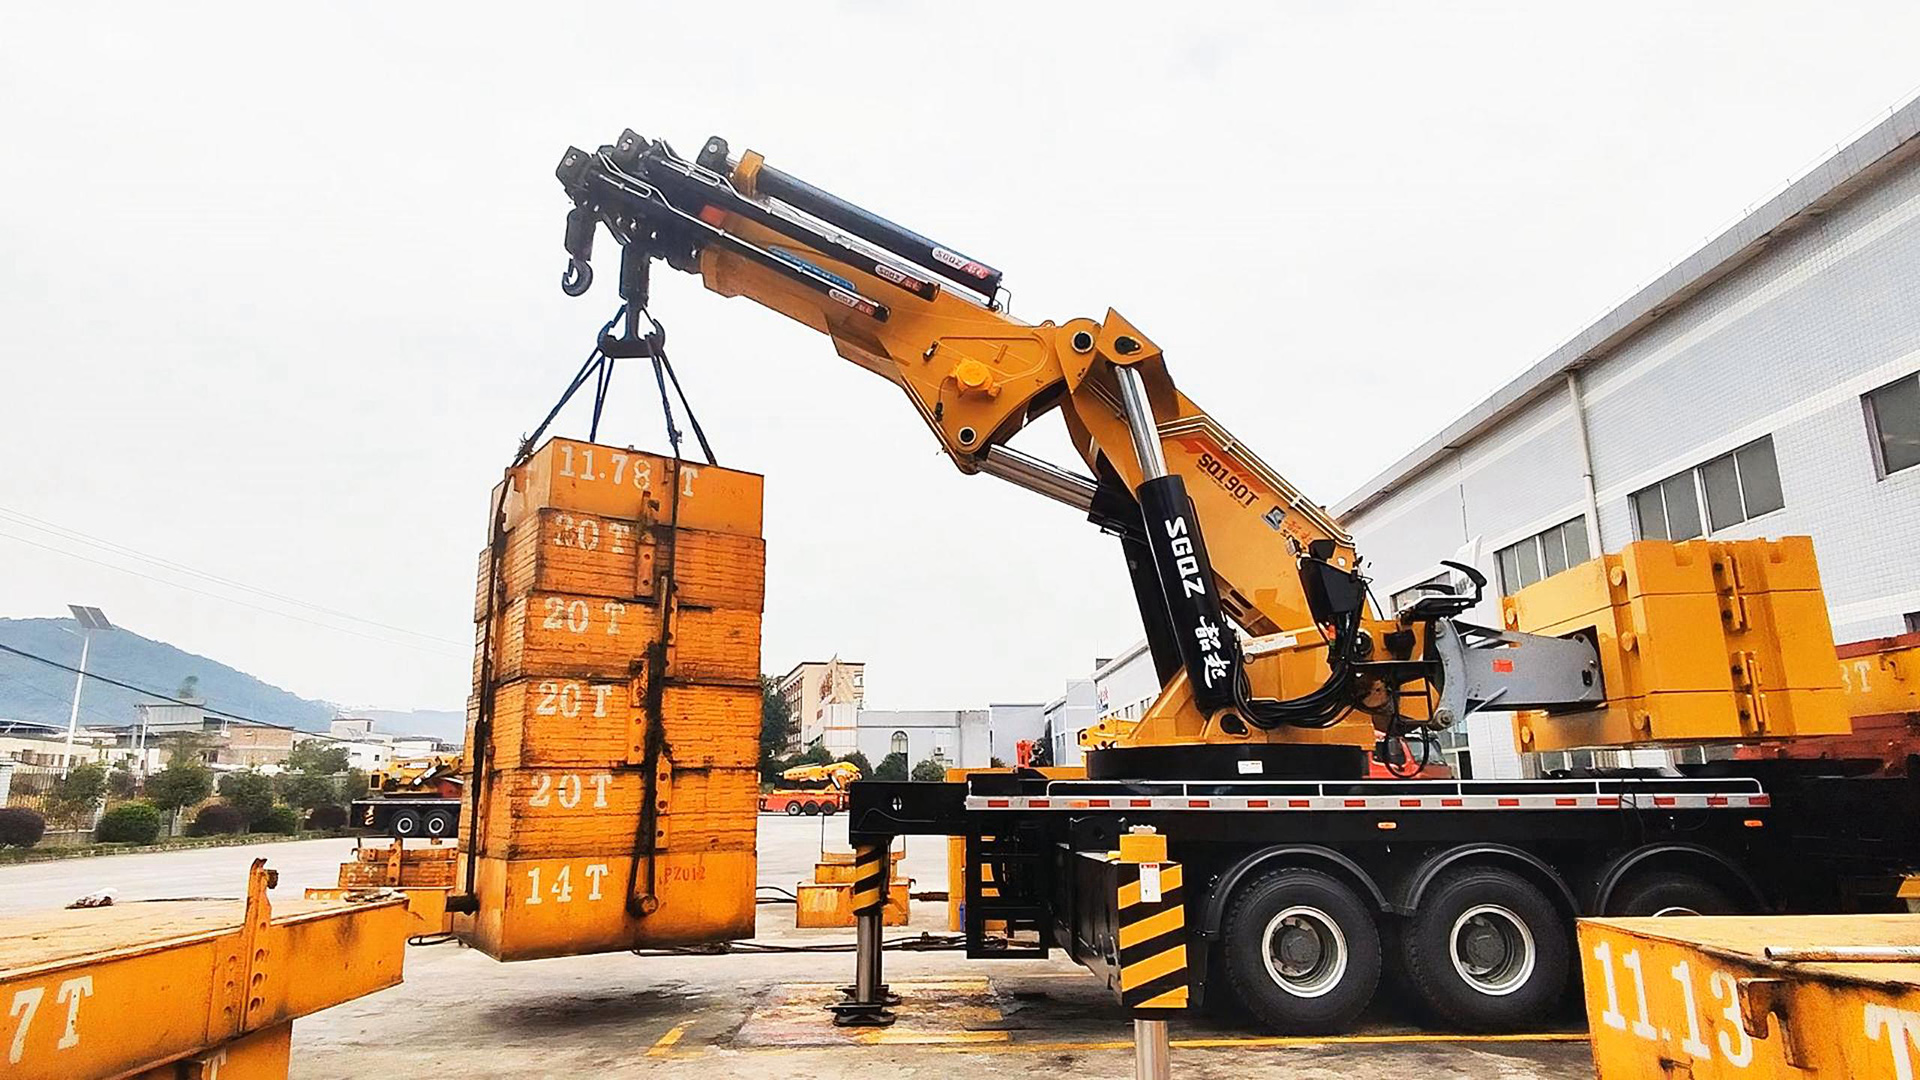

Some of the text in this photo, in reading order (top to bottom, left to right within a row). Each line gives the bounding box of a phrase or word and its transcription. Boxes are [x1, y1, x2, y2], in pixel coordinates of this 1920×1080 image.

[559, 445, 698, 497] 11.78 T
[1198, 453, 1259, 506] SQ190T
[608, 522, 630, 554] T
[1164, 516, 1206, 598] SGQZ
[543, 597, 625, 635] 20 T
[536, 682, 612, 718] 20 T
[1593, 940, 1753, 1068] 11.13
